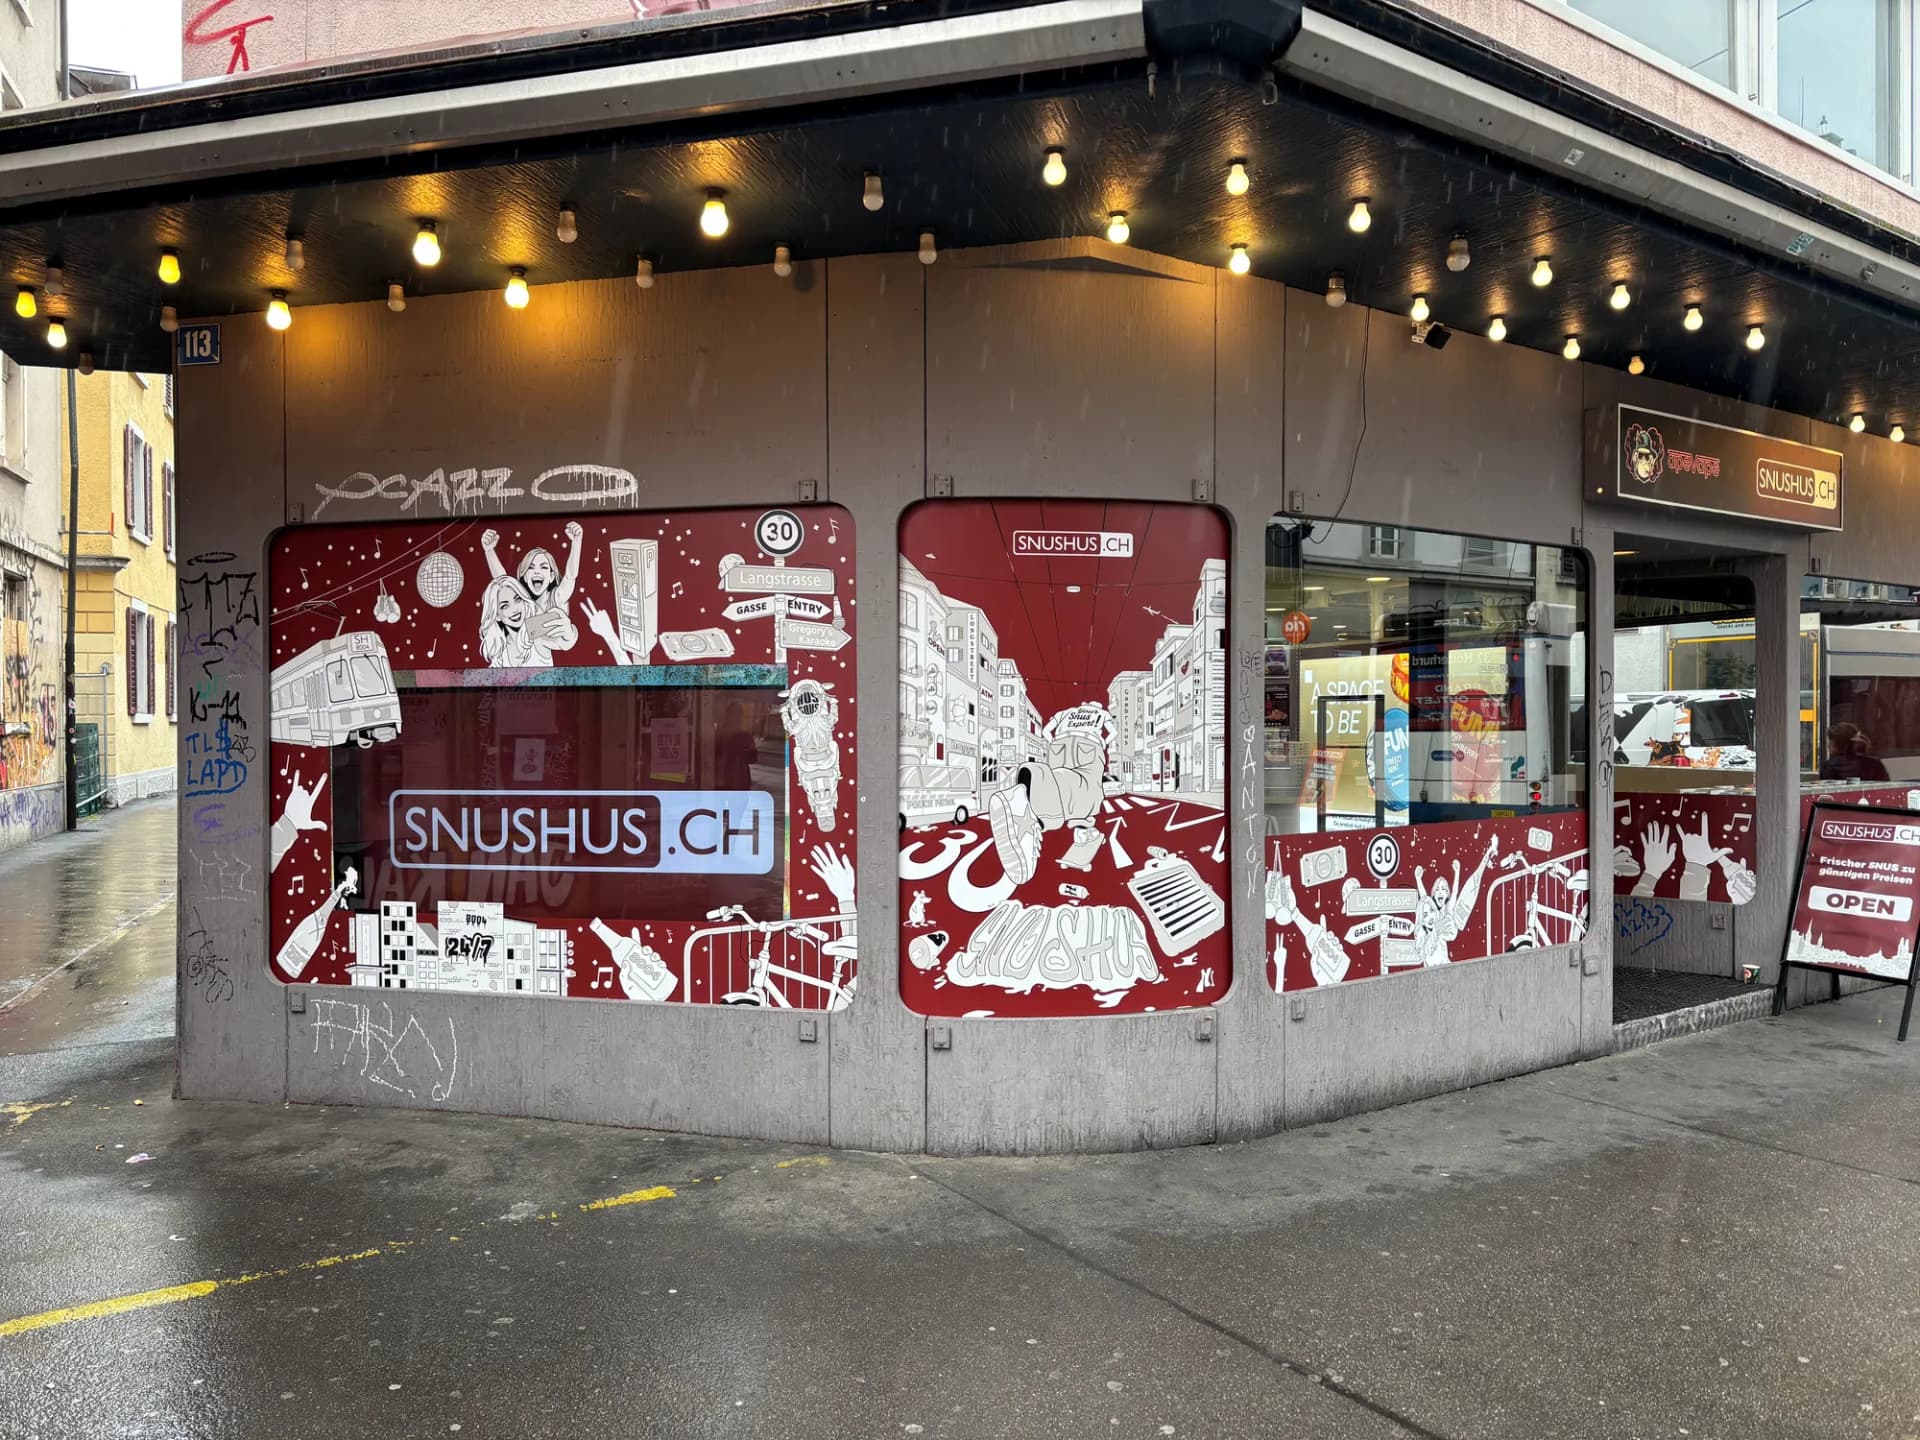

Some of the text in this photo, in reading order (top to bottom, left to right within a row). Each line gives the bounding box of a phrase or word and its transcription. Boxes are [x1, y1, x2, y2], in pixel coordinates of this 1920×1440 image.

[185, 329, 211, 358] 113
[1759, 468, 1835, 501] SNUSHUS.CH
[766, 522, 793, 541] 30
[1018, 535, 1130, 553] SNUSHUS.CH
[740, 570, 822, 588] Langstrasse
[736, 602, 767, 615] GASSE
[787, 600, 823, 614] ENTRY
[788, 622, 833, 637] Gregory's
[354, 634, 369, 645] SH
[928, 637, 945, 657] OPEN
[967, 614, 976, 680] LONGSTREET
[980, 688, 994, 700] ATM
[1310, 681, 1321, 705] A
[1327, 680, 1385, 706] SPACE
[1068, 711, 1091, 721] Snus
[1338, 709, 1363, 734] BE
[185, 759, 247, 797] LAPD
[405, 806, 760, 857] SNUSHUS.CH
[1374, 845, 1393, 865] 30
[1819, 856, 1916, 874] Frischer SNUS zu
[1818, 867, 1913, 885] günstigen Preisen
[1356, 892, 1411, 911] Langstrasse
[1826, 893, 1896, 916] OPEN
[1353, 923, 1376, 938] GASSE
[1388, 919, 1412, 931] ENTRY
[446, 934, 494, 965] 24/7
